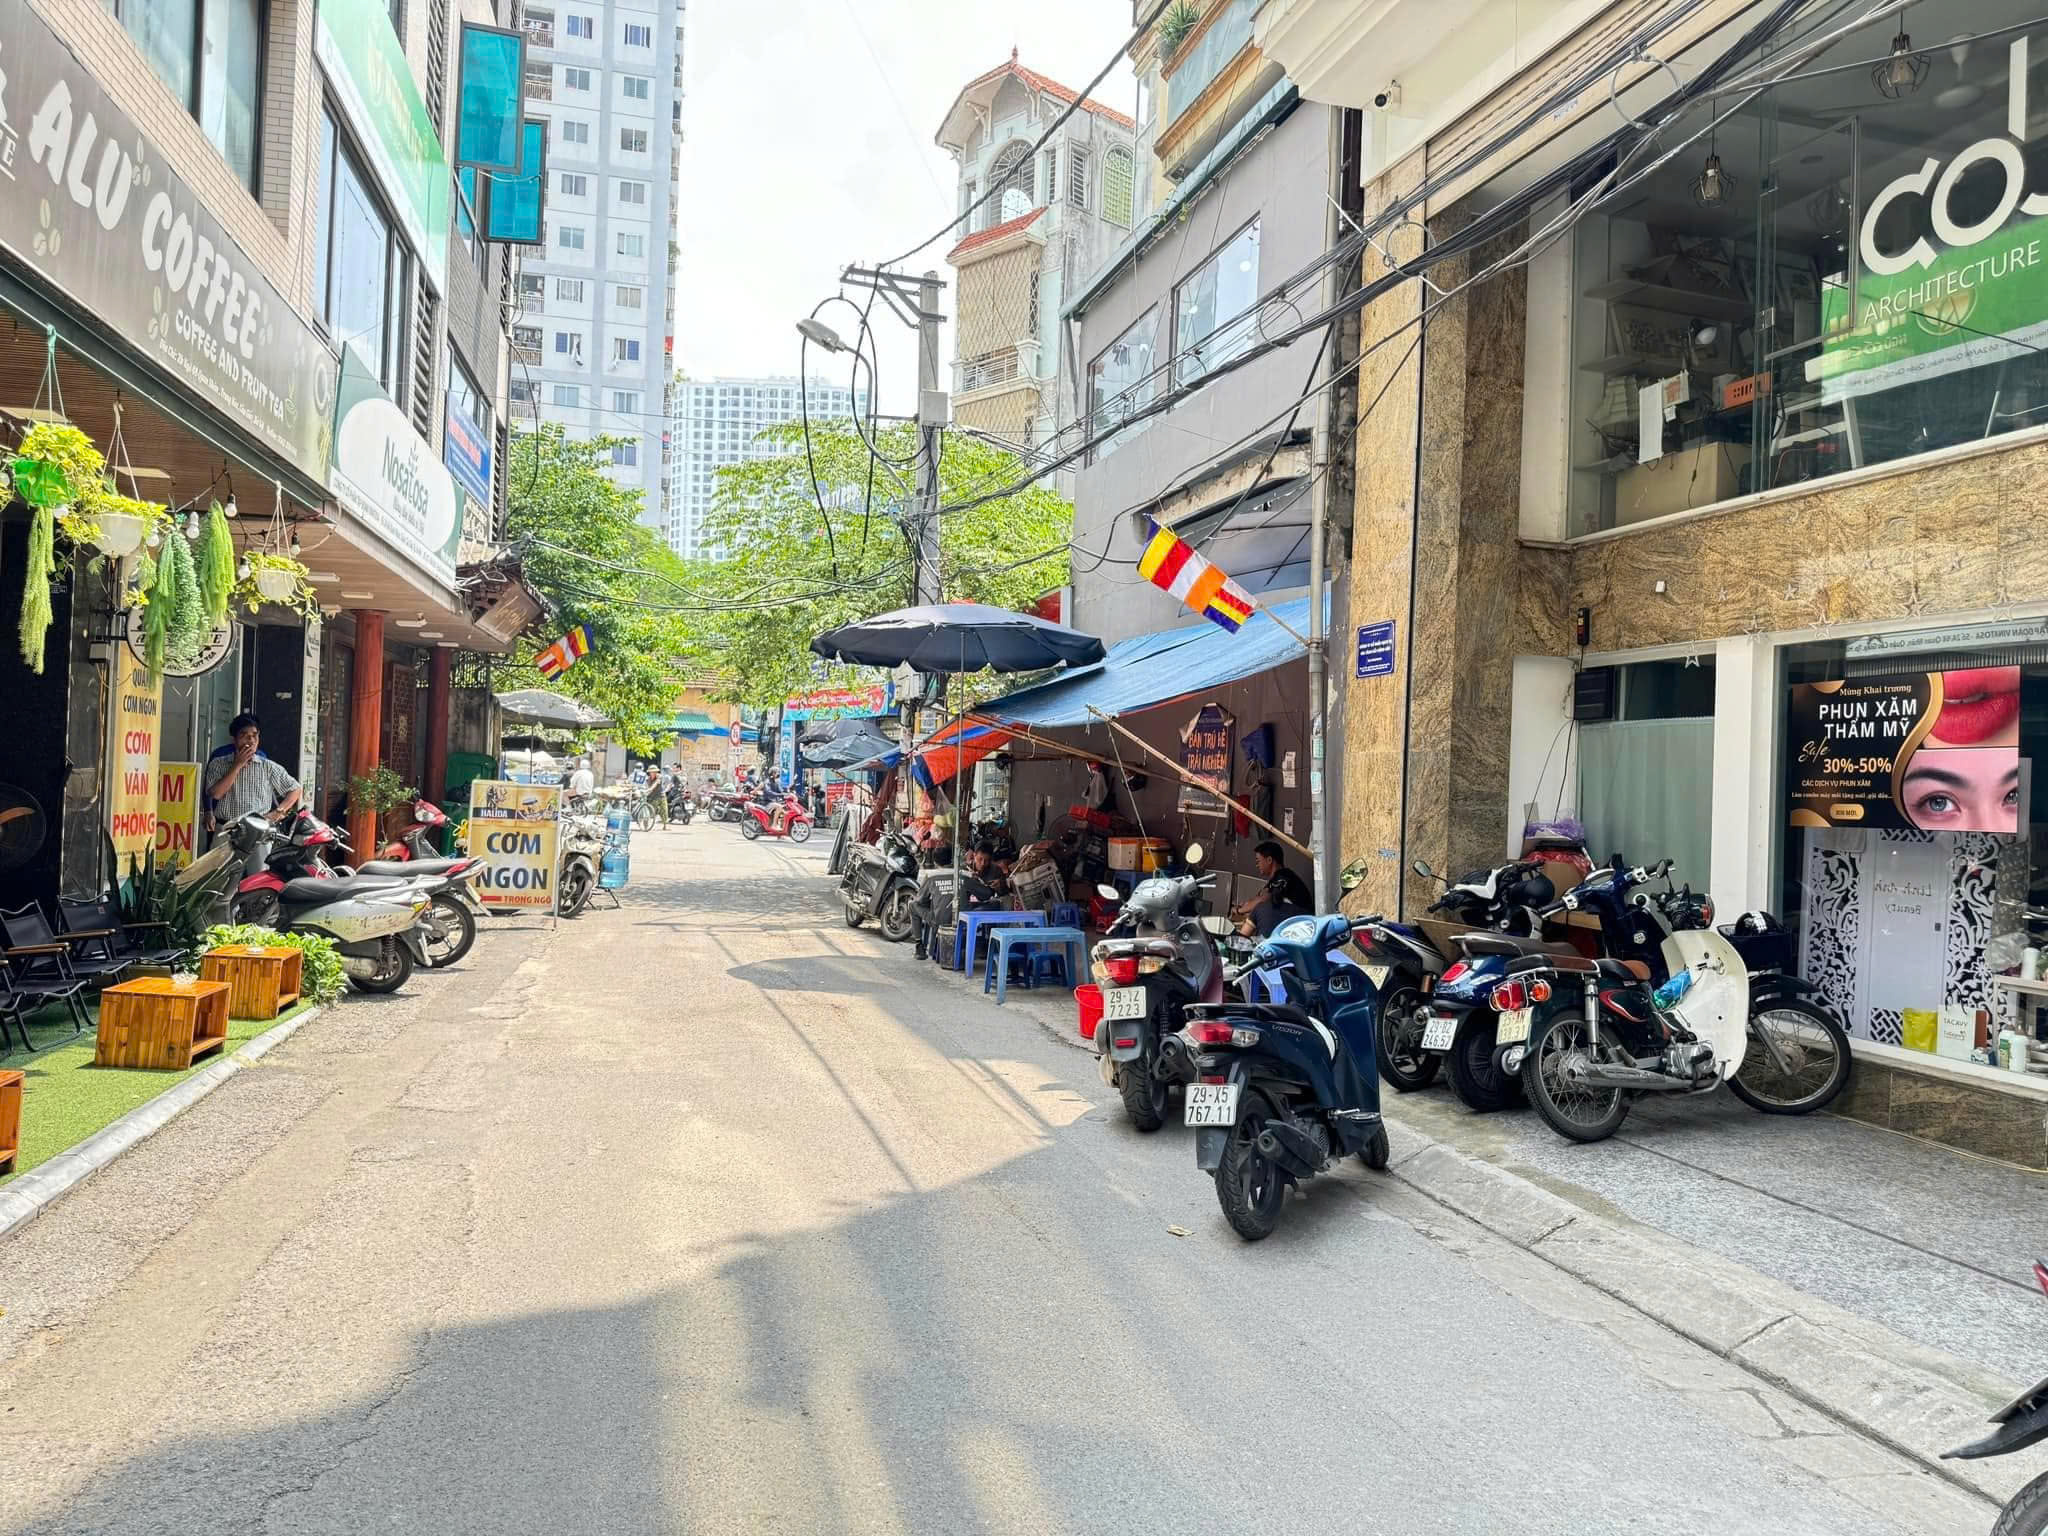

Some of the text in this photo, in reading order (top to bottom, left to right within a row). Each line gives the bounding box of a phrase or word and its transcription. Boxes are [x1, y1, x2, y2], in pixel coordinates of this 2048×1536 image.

[29, 80, 261, 360] ALU COFFEE
[1863, 240, 2041, 326] ARCHITECTURE
[175, 307, 285, 422] COFFEE AND FRUIT TEA
[1819, 696, 1918, 721] PHUN XĂM
[1883, 717, 1910, 738] MỸ
[125, 730, 152, 755] CƠM
[1797, 735, 1832, 764] Sale
[1823, 757, 1892, 774] 30%-50%
[124, 767, 149, 795] VĂN
[112, 808, 157, 838] PHÒNG
[486, 831, 541, 855] CƠM
[475, 867, 549, 890] NGON
[504, 895, 533, 905] TRONG
[1110, 1003, 1140, 1018] 7223
[1192, 1086, 1229, 1104] 29-X5
[1187, 1105, 1232, 1123] 767.11
